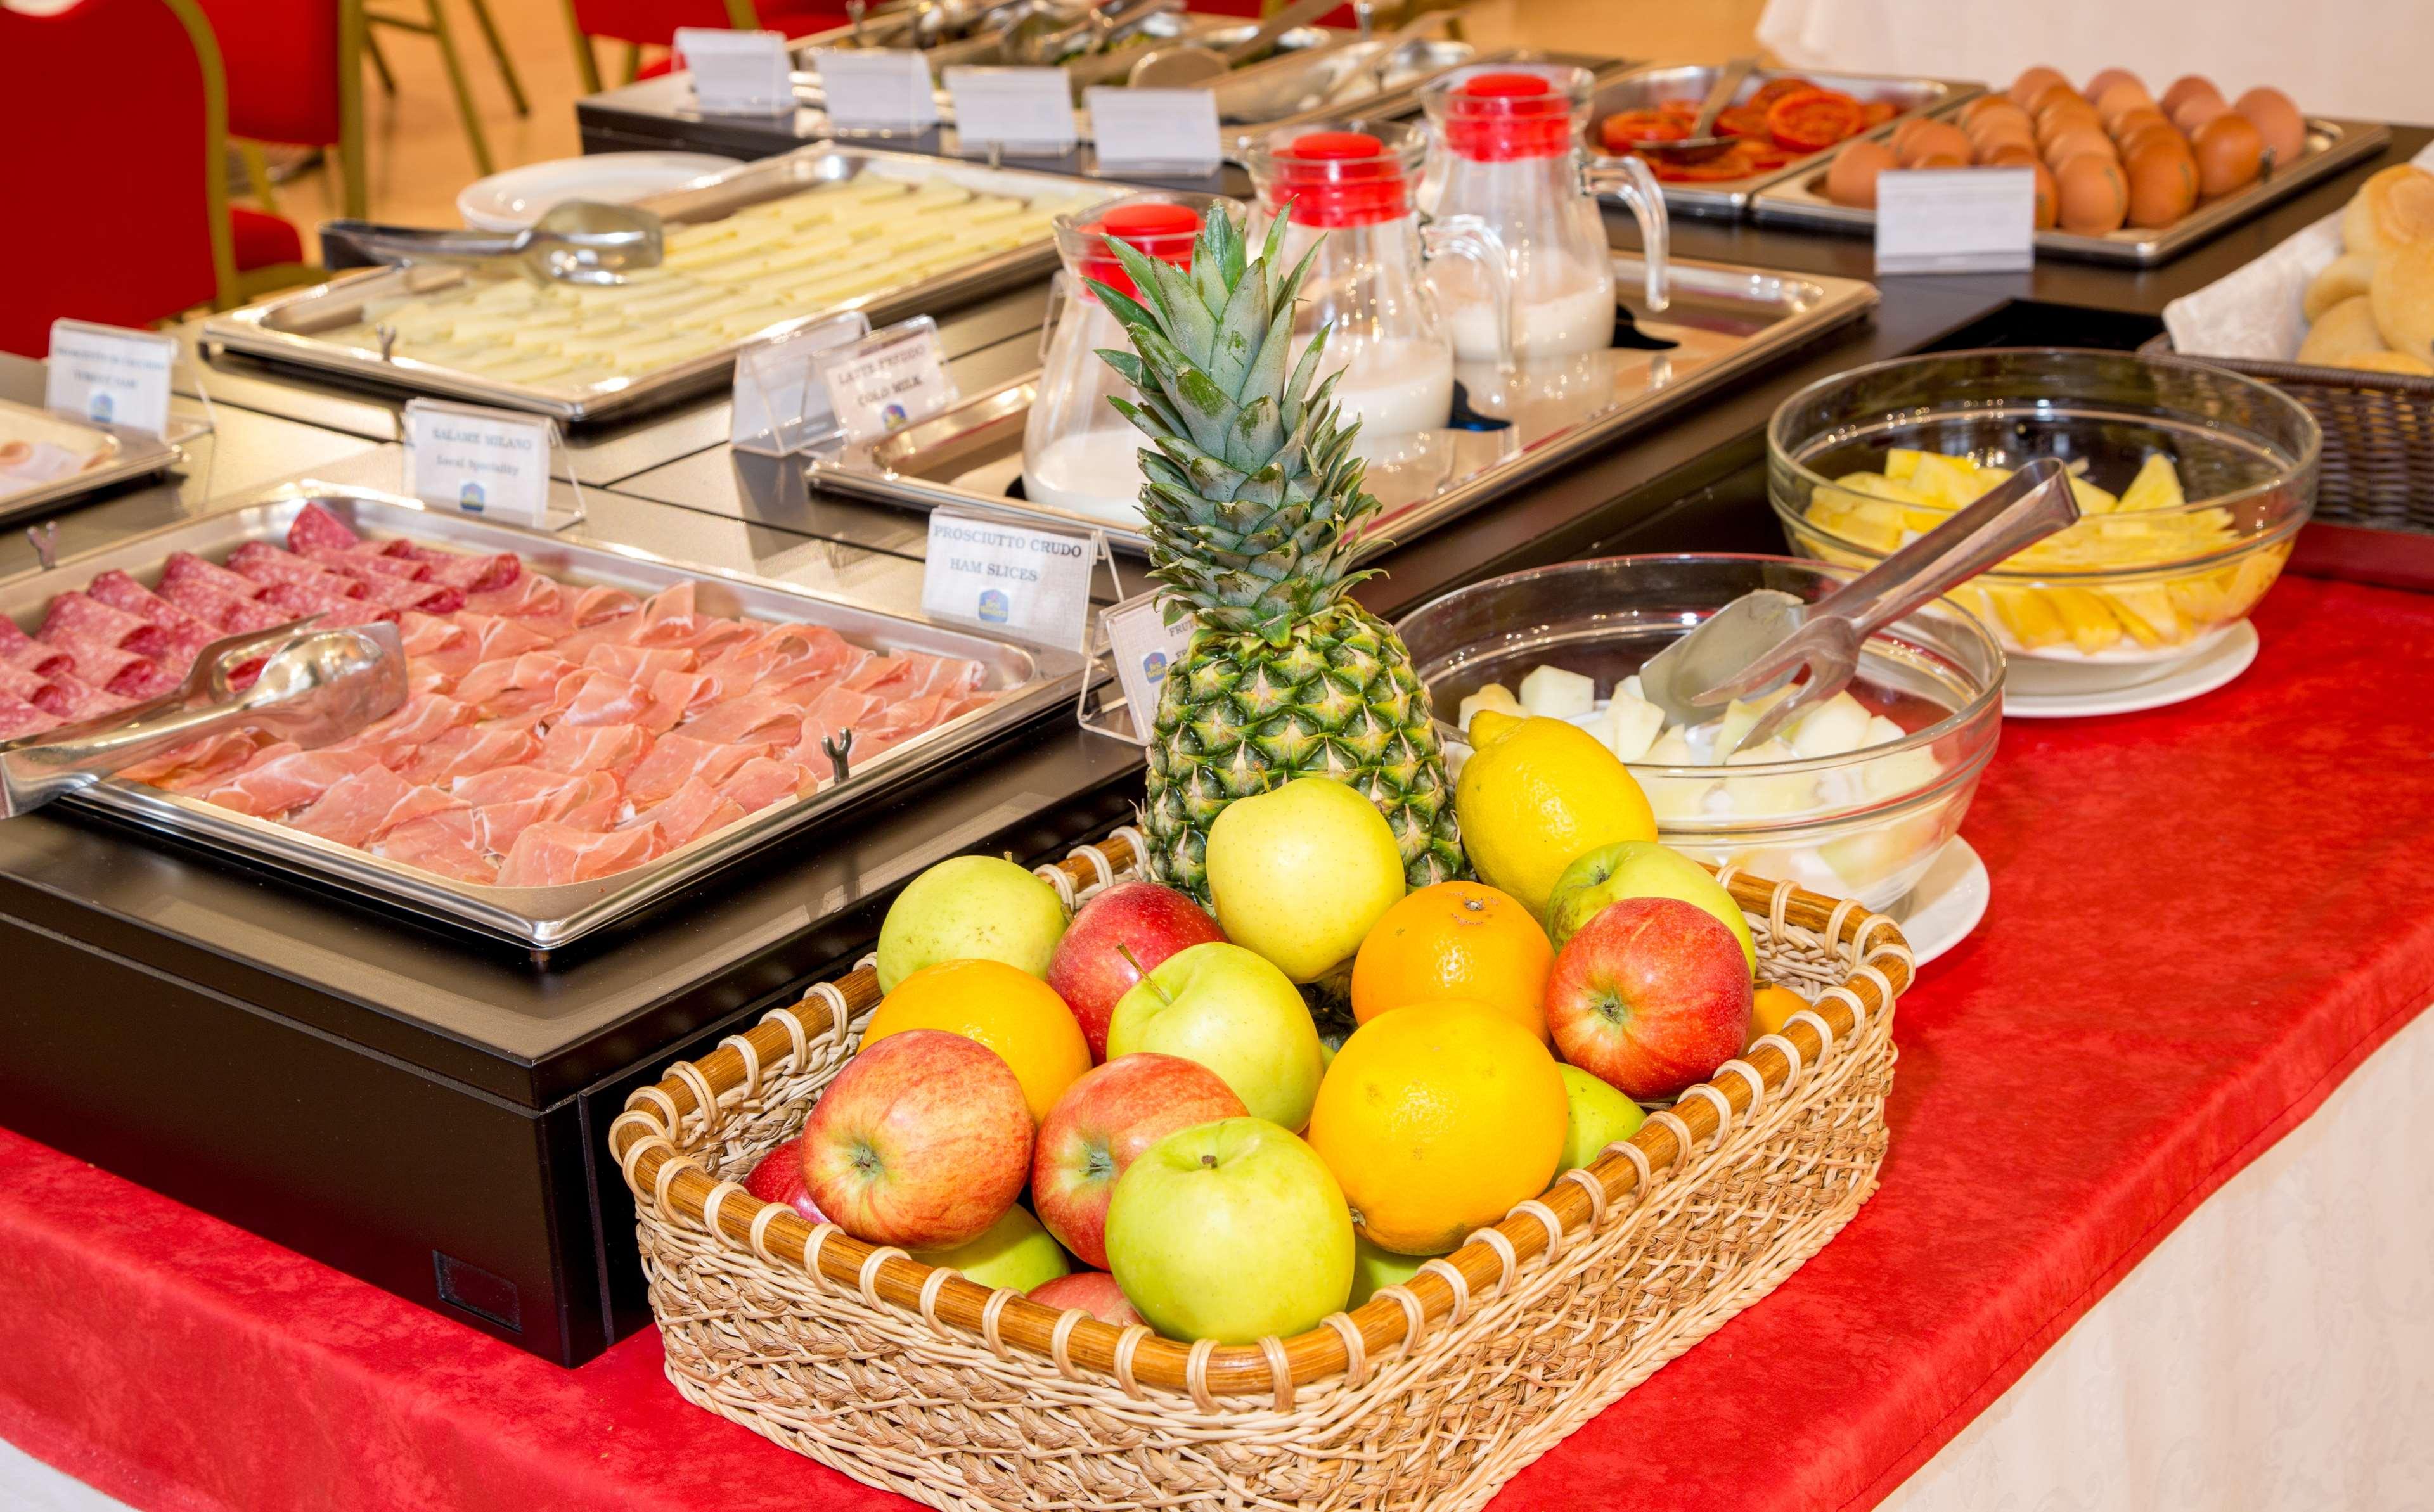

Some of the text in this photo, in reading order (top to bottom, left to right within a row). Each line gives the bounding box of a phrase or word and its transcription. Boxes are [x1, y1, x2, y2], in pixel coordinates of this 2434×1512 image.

[934, 525, 1082, 558] PROSCIUTTO CRUDO
[950, 558, 1038, 582] HAM SLICES
